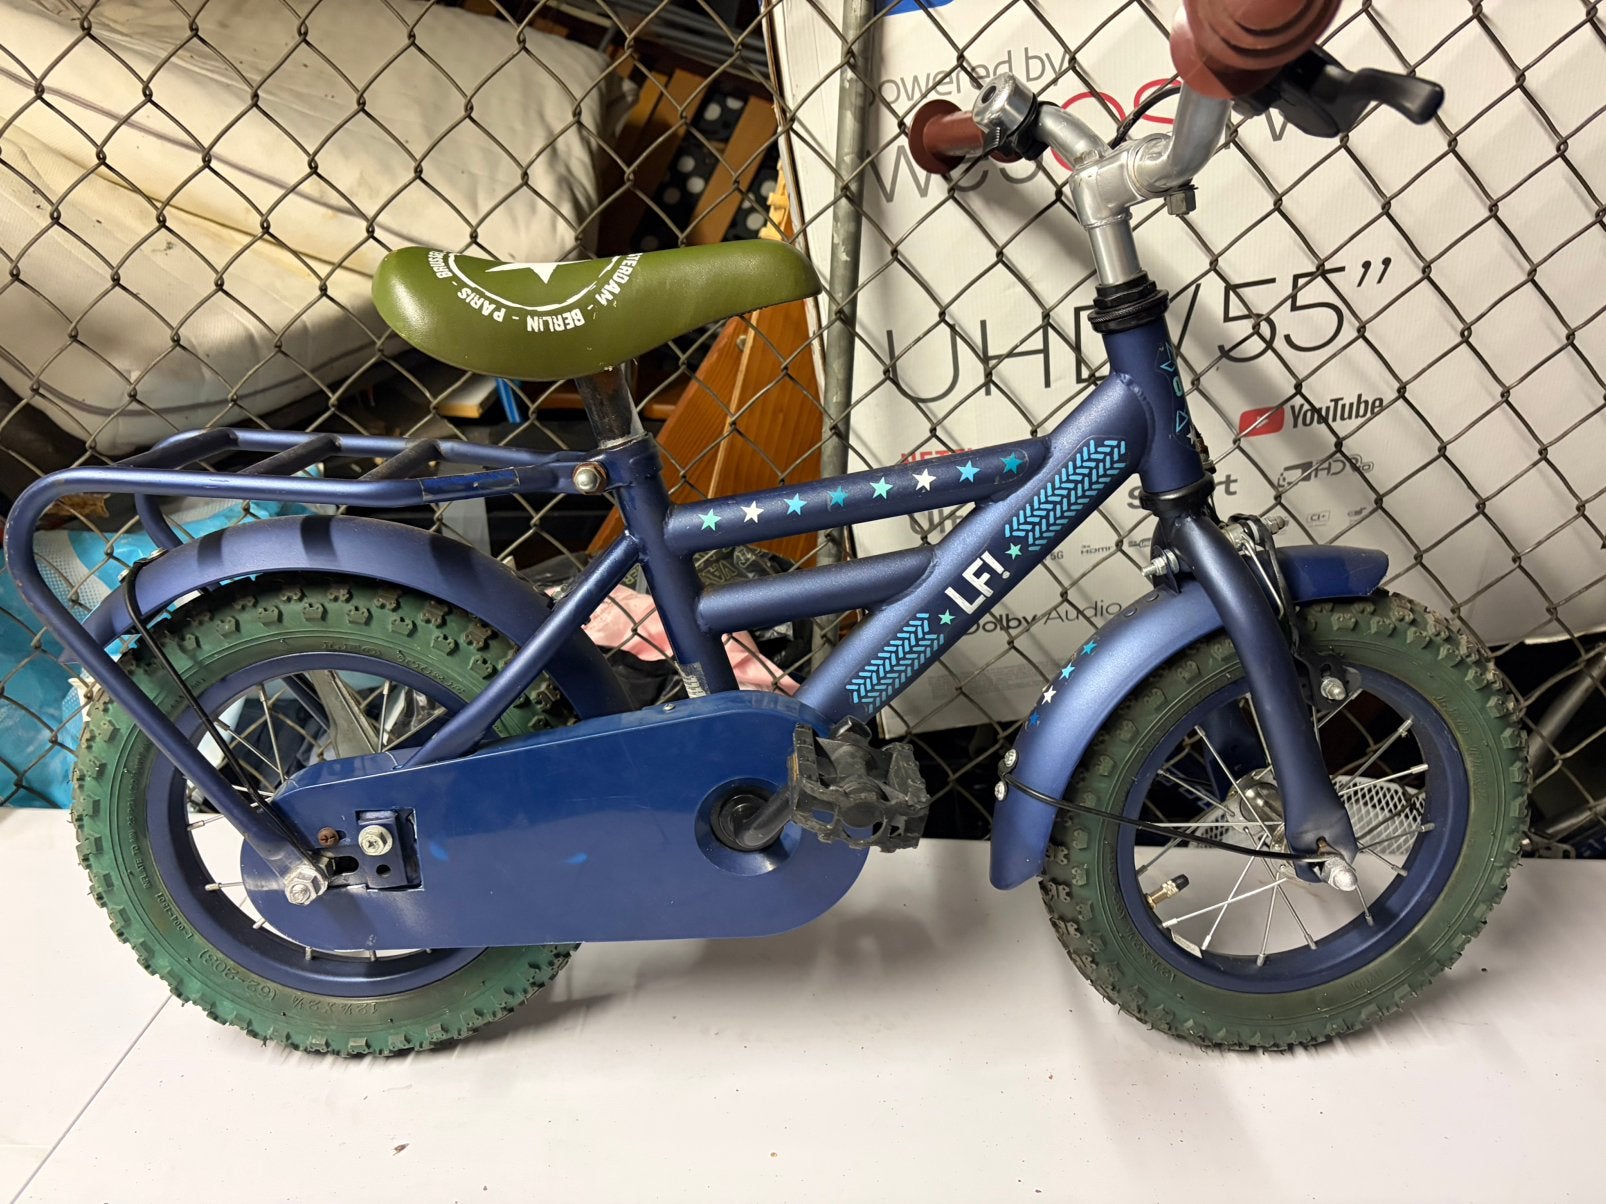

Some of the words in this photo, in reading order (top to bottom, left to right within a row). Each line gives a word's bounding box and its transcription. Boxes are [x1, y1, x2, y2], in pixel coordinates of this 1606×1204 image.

[870, 50, 1013, 106] owered
[1023, 46, 1069, 87] by
[595, 252, 644, 306] TERDAM
[457, 287, 507, 322] PARIS
[526, 308, 586, 333] BERLIN
[1290, 393, 1384, 429] YouTube
[944, 550, 1010, 615] LF!
[1043, 599, 1122, 625] Audio
